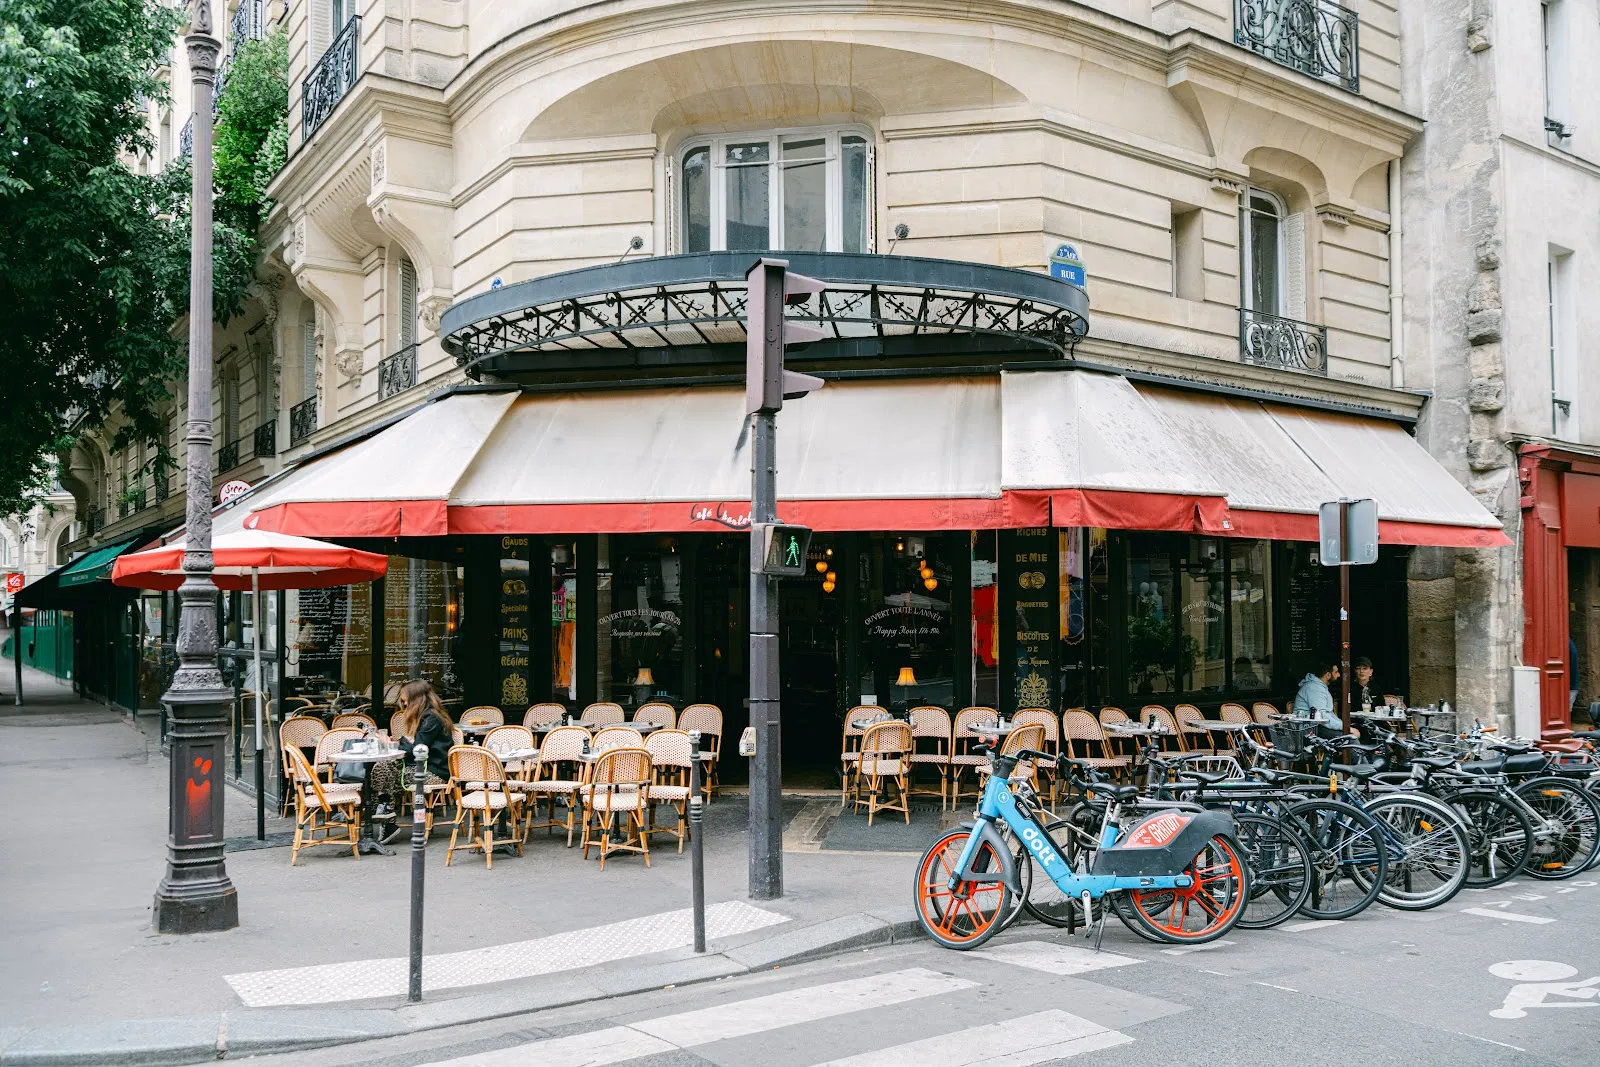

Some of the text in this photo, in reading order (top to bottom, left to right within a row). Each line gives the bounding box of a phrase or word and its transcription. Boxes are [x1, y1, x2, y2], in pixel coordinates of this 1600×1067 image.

[1061, 270, 1075, 280] RUE
[690, 503, 713, 520] Café
[501, 536, 529, 549] CHAUDS
[1016, 552, 1048, 562] DE MIE
[864, 608, 890, 625] OUVERT
[890, 606, 912, 615] TOUTE
[502, 627, 529, 641] PAINS
[873, 625, 898, 638] Happy
[898, 625, 917, 635] Hour
[1016, 631, 1050, 641] BISCOTTES
[1147, 816, 1180, 843] GRATUIT
[1022, 827, 1056, 867] dott
